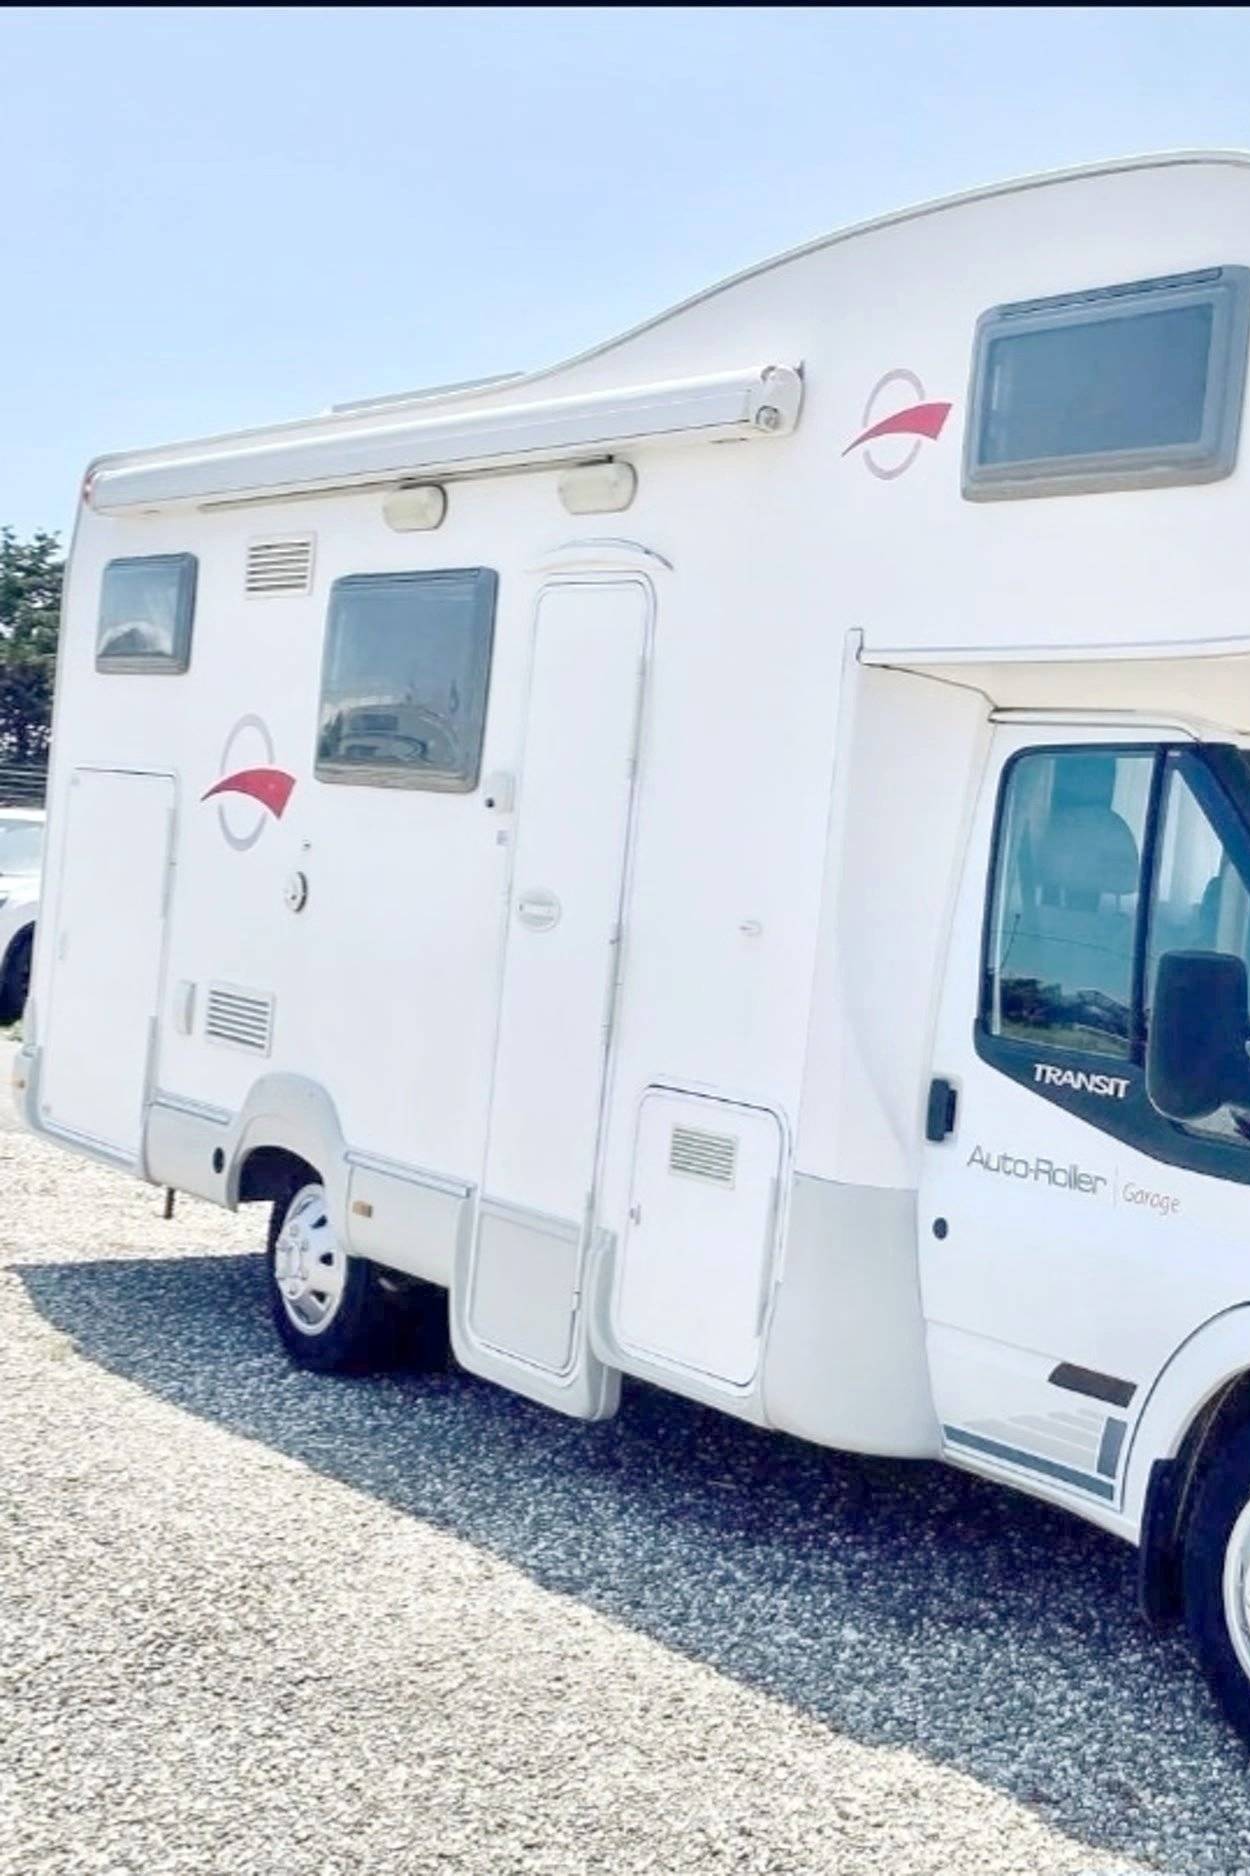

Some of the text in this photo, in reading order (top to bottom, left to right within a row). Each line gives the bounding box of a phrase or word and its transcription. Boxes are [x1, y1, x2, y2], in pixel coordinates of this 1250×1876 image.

[1033, 1063, 1130, 1098] TRANSIT
[967, 1145, 1181, 1216] Auto-Roller Garage
